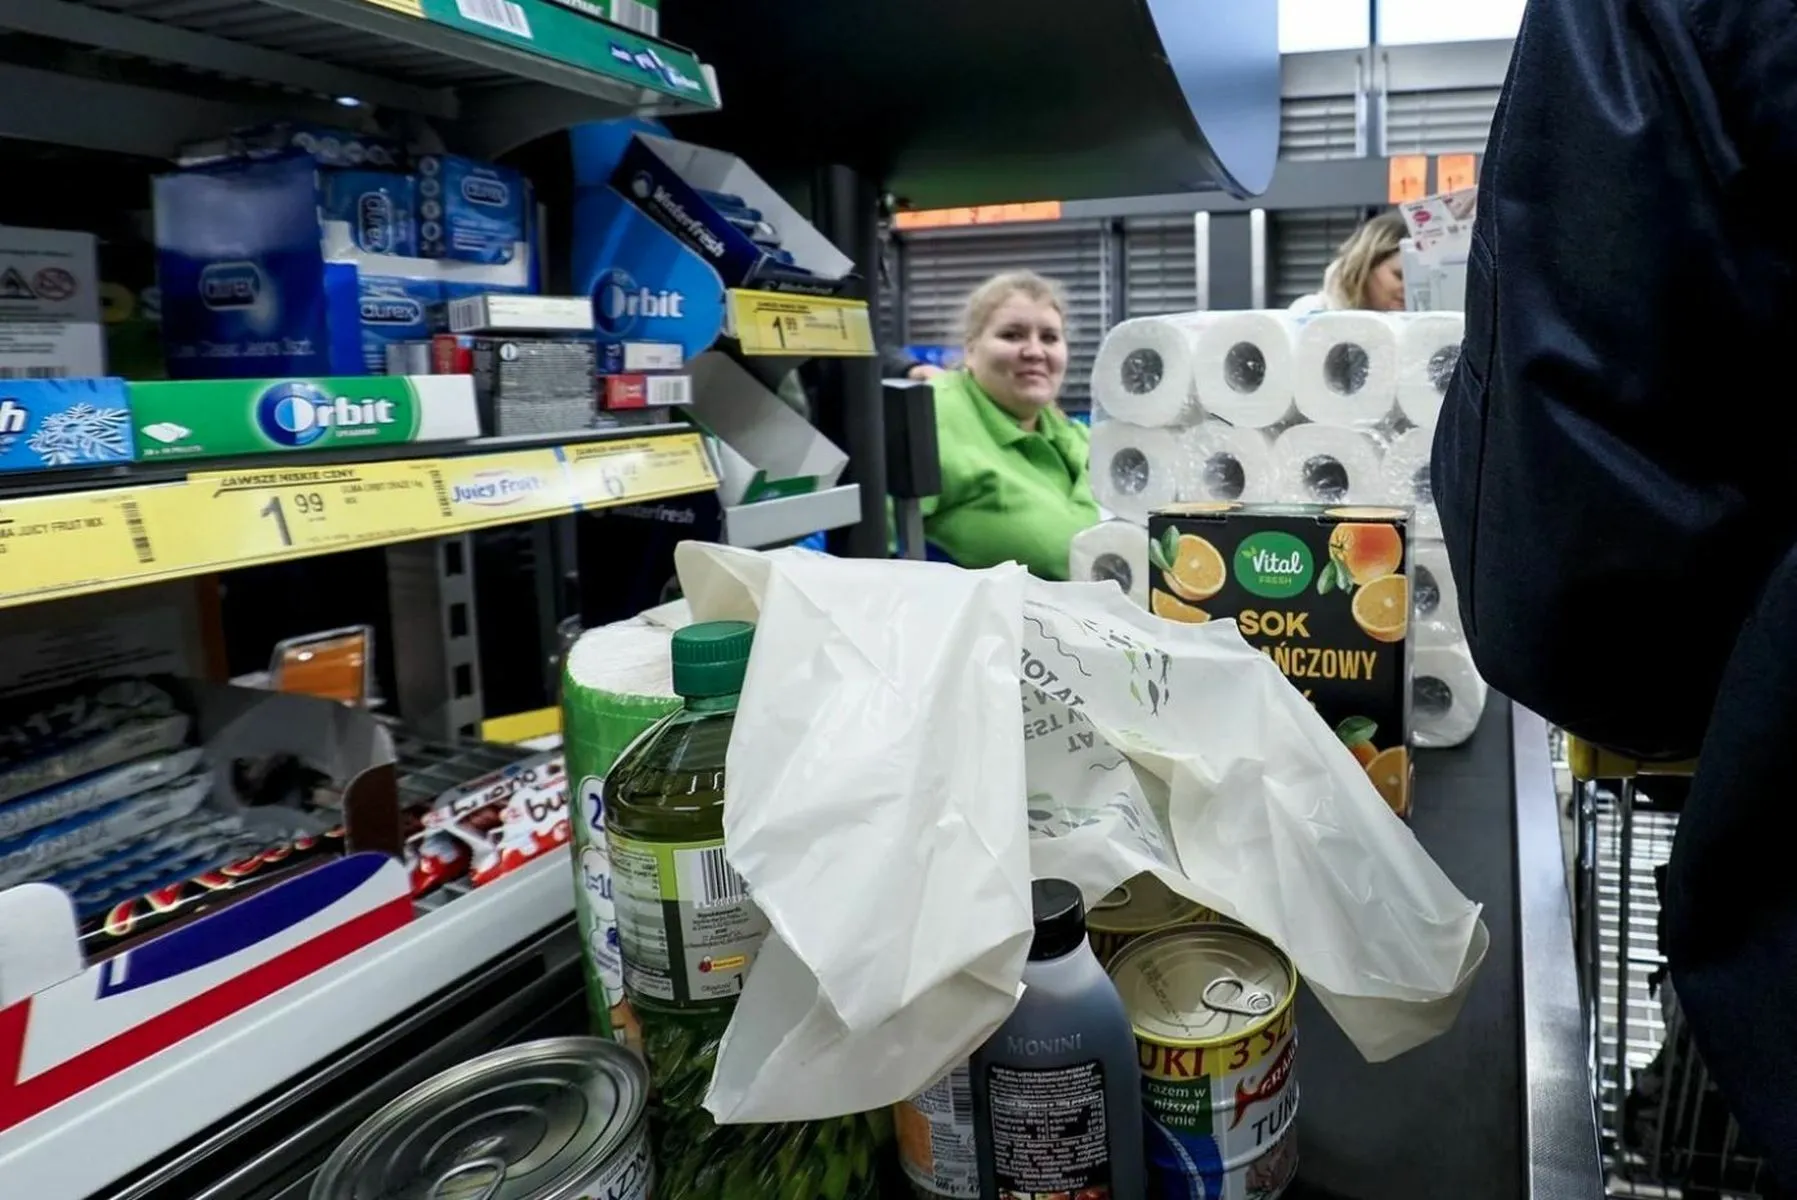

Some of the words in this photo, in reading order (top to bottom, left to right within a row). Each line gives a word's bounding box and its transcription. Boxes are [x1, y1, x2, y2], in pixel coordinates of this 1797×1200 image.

[653, 186, 725, 257] Winterfresh
[361, 300, 415, 319] durex
[597, 277, 684, 324] Orbit
[772, 316, 786, 349] 1
[262, 391, 395, 441] Orbit
[220, 471, 276, 487] ZAWSZE
[278, 470, 321, 484] NISKIE
[323, 468, 356, 480] CENY
[452, 480, 495, 503] Juicy
[261, 496, 293, 546] 1
[294, 492, 324, 514] 99
[1253, 549, 1304, 575] Vital
[1258, 575, 1292, 586] FRESH
[1239, 609, 1311, 638] SOK
[1008, 1033, 1081, 1056] MONINI
[1138, 1043, 1204, 1077] UKI
[1147, 1080, 1189, 1098] razem
[1194, 1088, 1207, 1098] w
[1160, 1113, 1196, 1127] cenie
